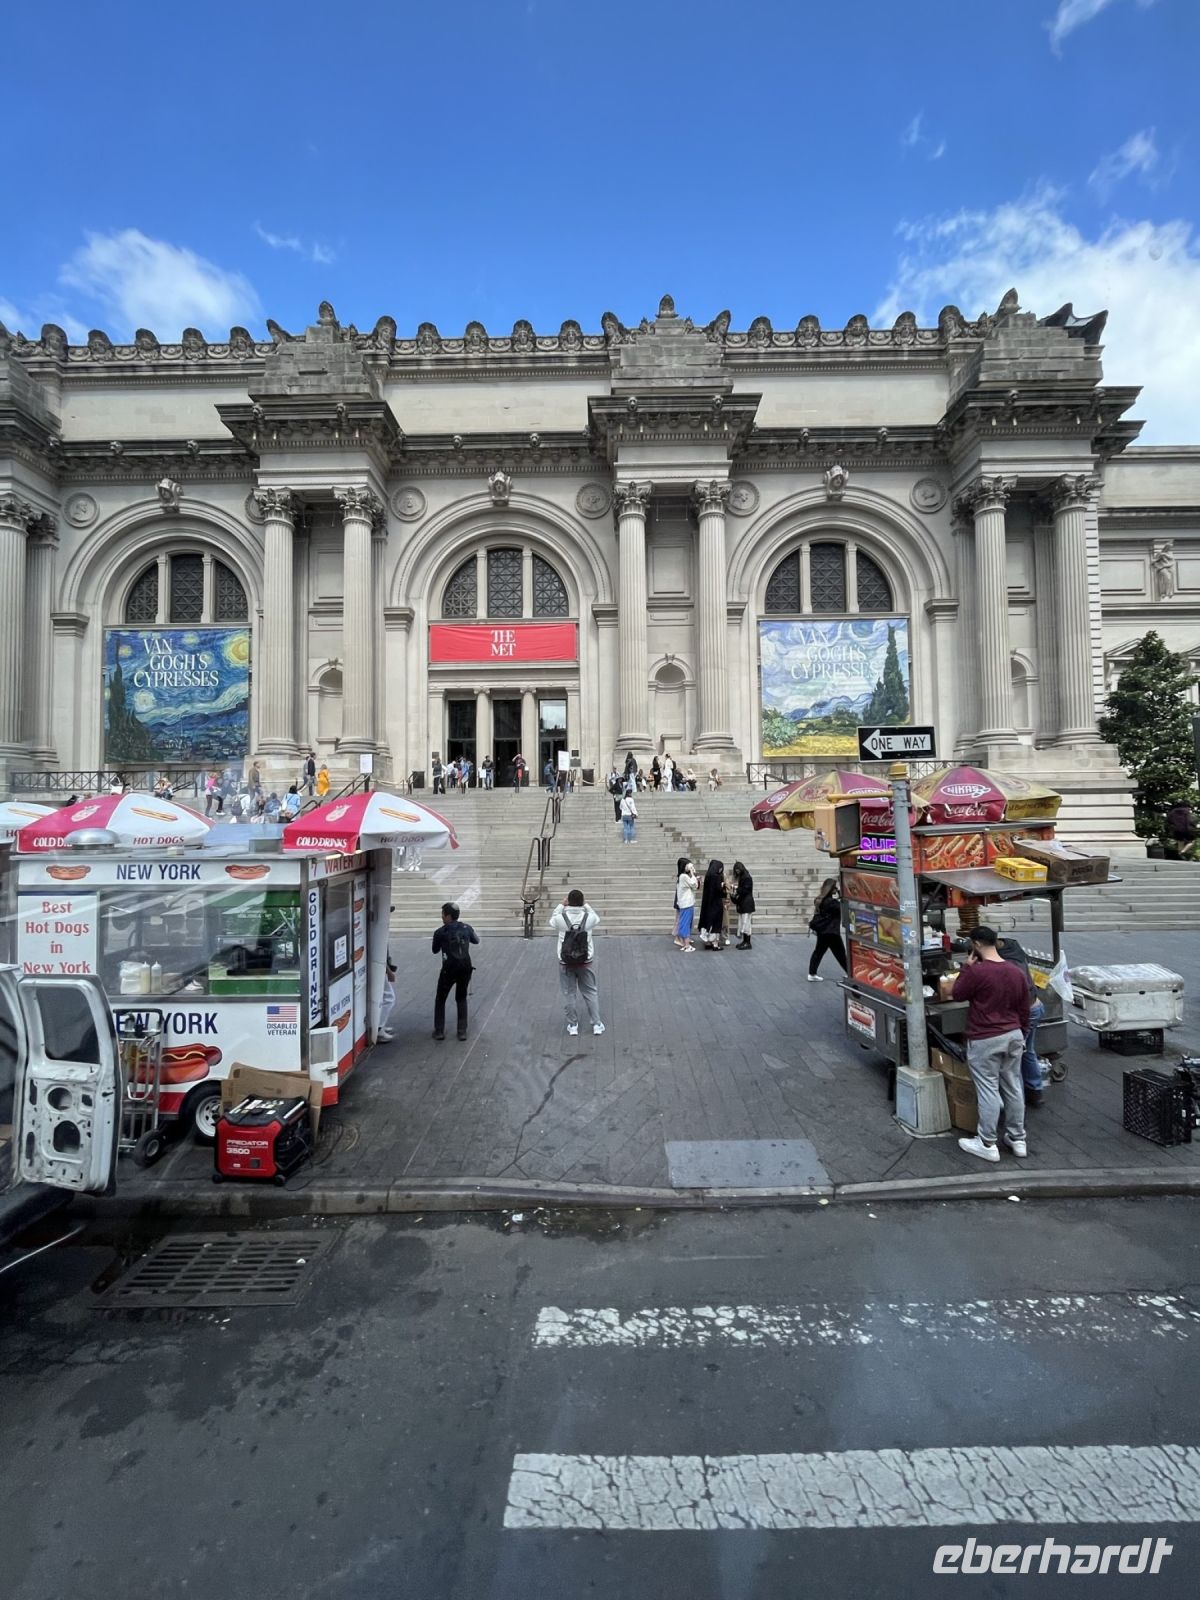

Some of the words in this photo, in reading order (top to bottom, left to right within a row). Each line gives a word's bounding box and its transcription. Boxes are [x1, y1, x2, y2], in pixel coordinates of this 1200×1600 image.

[491, 630, 515, 642] THE
[797, 629, 828, 646] VAN
[144, 638, 173, 654] VAN
[491, 643, 516, 656] MET
[806, 644, 866, 662] GOGH'S
[150, 654, 208, 670] GOGH'S
[134, 670, 219, 688] CYPRESSES
[791, 662, 880, 680] CYPRESSES
[871, 737, 893, 751] ONE
[904, 735, 926, 750] WAY
[33, 837, 56, 848] COLD
[133, 837, 153, 845] HOT
[157, 836, 185, 845] DOGS
[296, 837, 319, 847] COLD
[318, 837, 348, 848] DRINKS
[117, 864, 152, 880] NEW
[158, 864, 201, 880] YORK
[325, 857, 353, 875] WATER
[42, 901, 72, 914] Best
[309, 892, 318, 941] COLD
[25, 921, 49, 934] Hot
[55, 921, 90, 936] Dogs
[50, 941, 63, 954] in
[23, 962, 54, 974] New
[59, 961, 91, 974] York
[310, 946, 320, 1020] DRINKS
[162, 1013, 218, 1034] YORK
